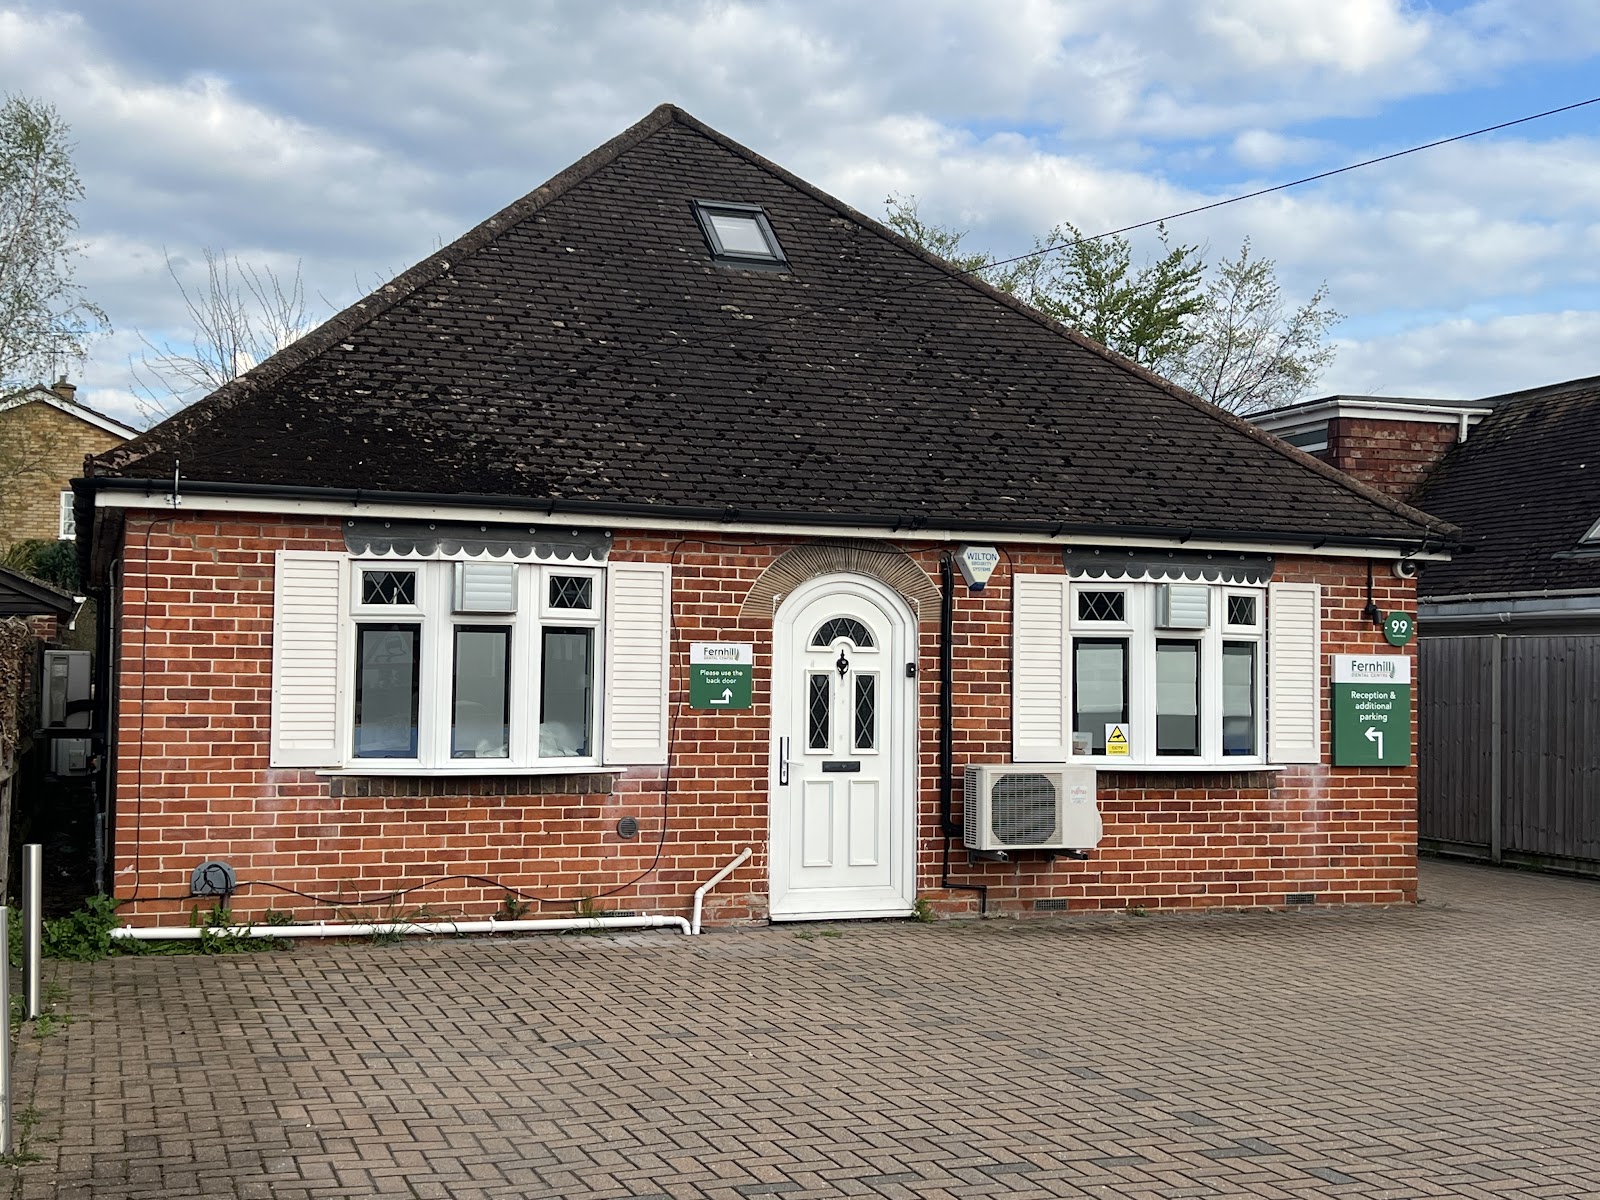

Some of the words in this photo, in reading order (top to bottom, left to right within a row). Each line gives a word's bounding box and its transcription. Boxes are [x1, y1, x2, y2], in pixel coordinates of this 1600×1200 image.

[967, 552, 997, 561] WILTON
[1391, 620, 1408, 633] 99
[703, 647, 737, 656] Fernhill
[1351, 660, 1391, 672] Fernhill
[732, 669, 743, 677] the
[1351, 691, 1389, 701] Reception
[1389, 691, 1397, 700] &
[1355, 701, 1392, 710] additional
[1359, 713, 1388, 723] parking
